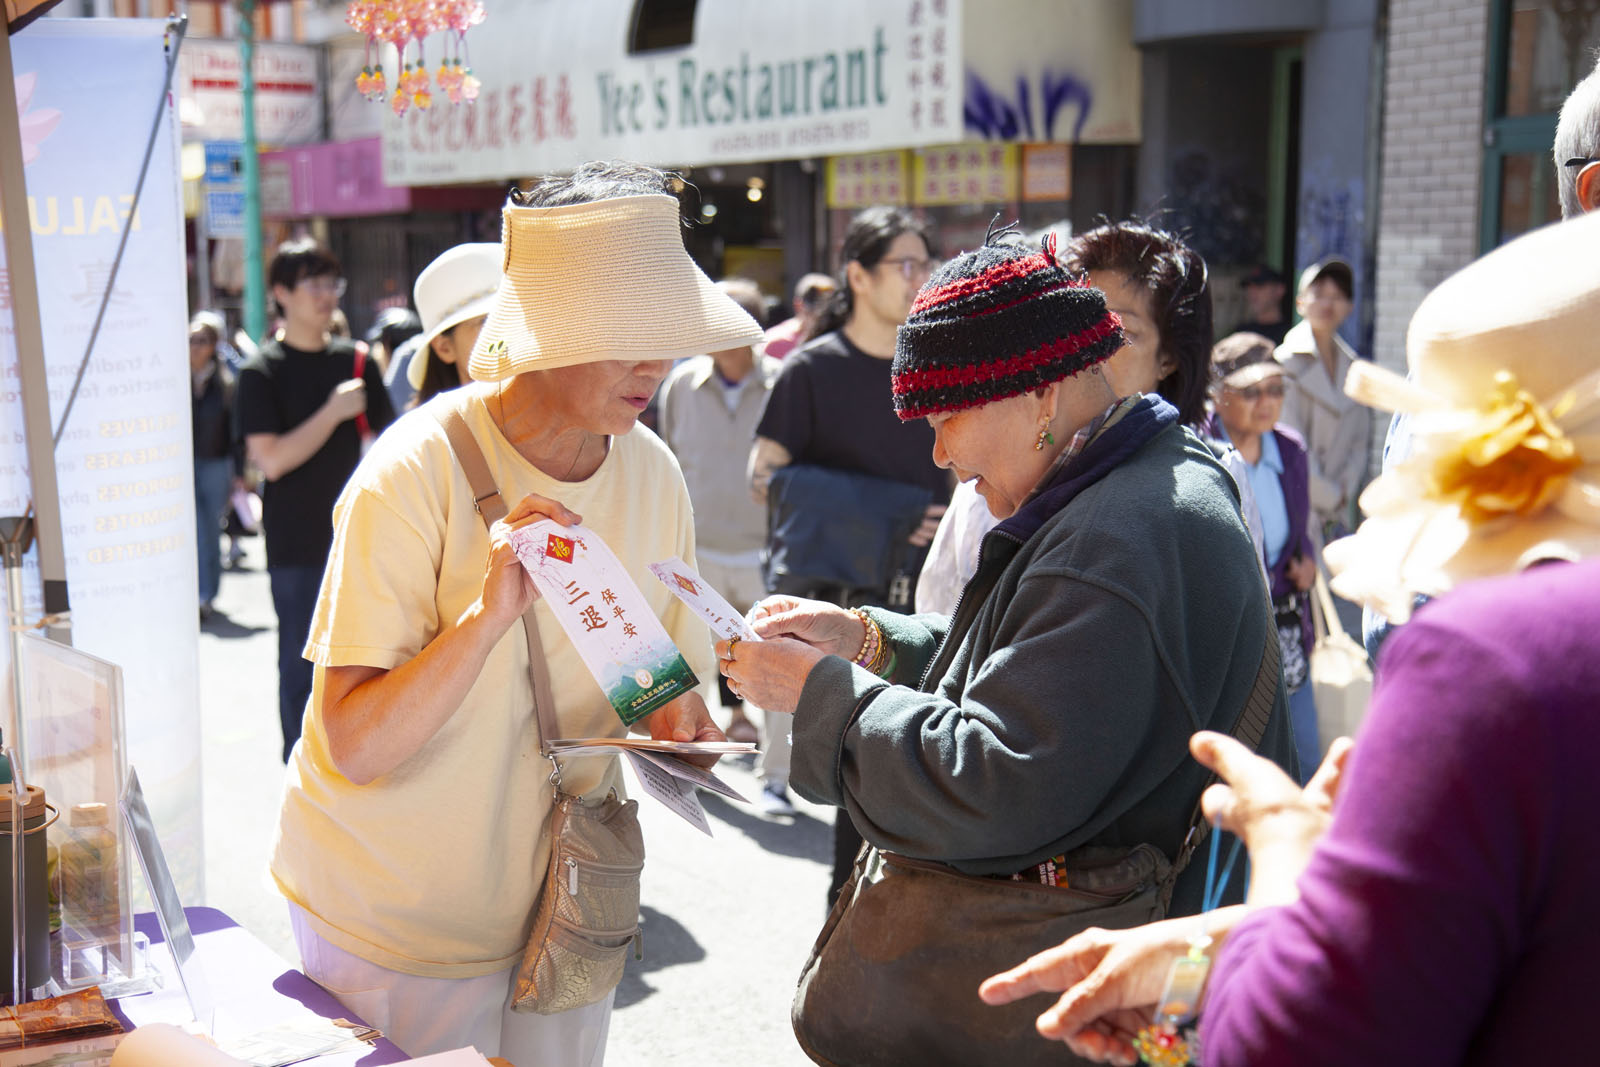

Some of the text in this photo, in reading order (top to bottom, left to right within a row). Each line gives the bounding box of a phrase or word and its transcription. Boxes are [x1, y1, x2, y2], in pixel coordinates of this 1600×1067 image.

[595, 61, 670, 138] Yee's
[678, 27, 889, 128] Restaurant
[565, 580, 608, 632] 三退
[601, 588, 638, 639] 保平安
